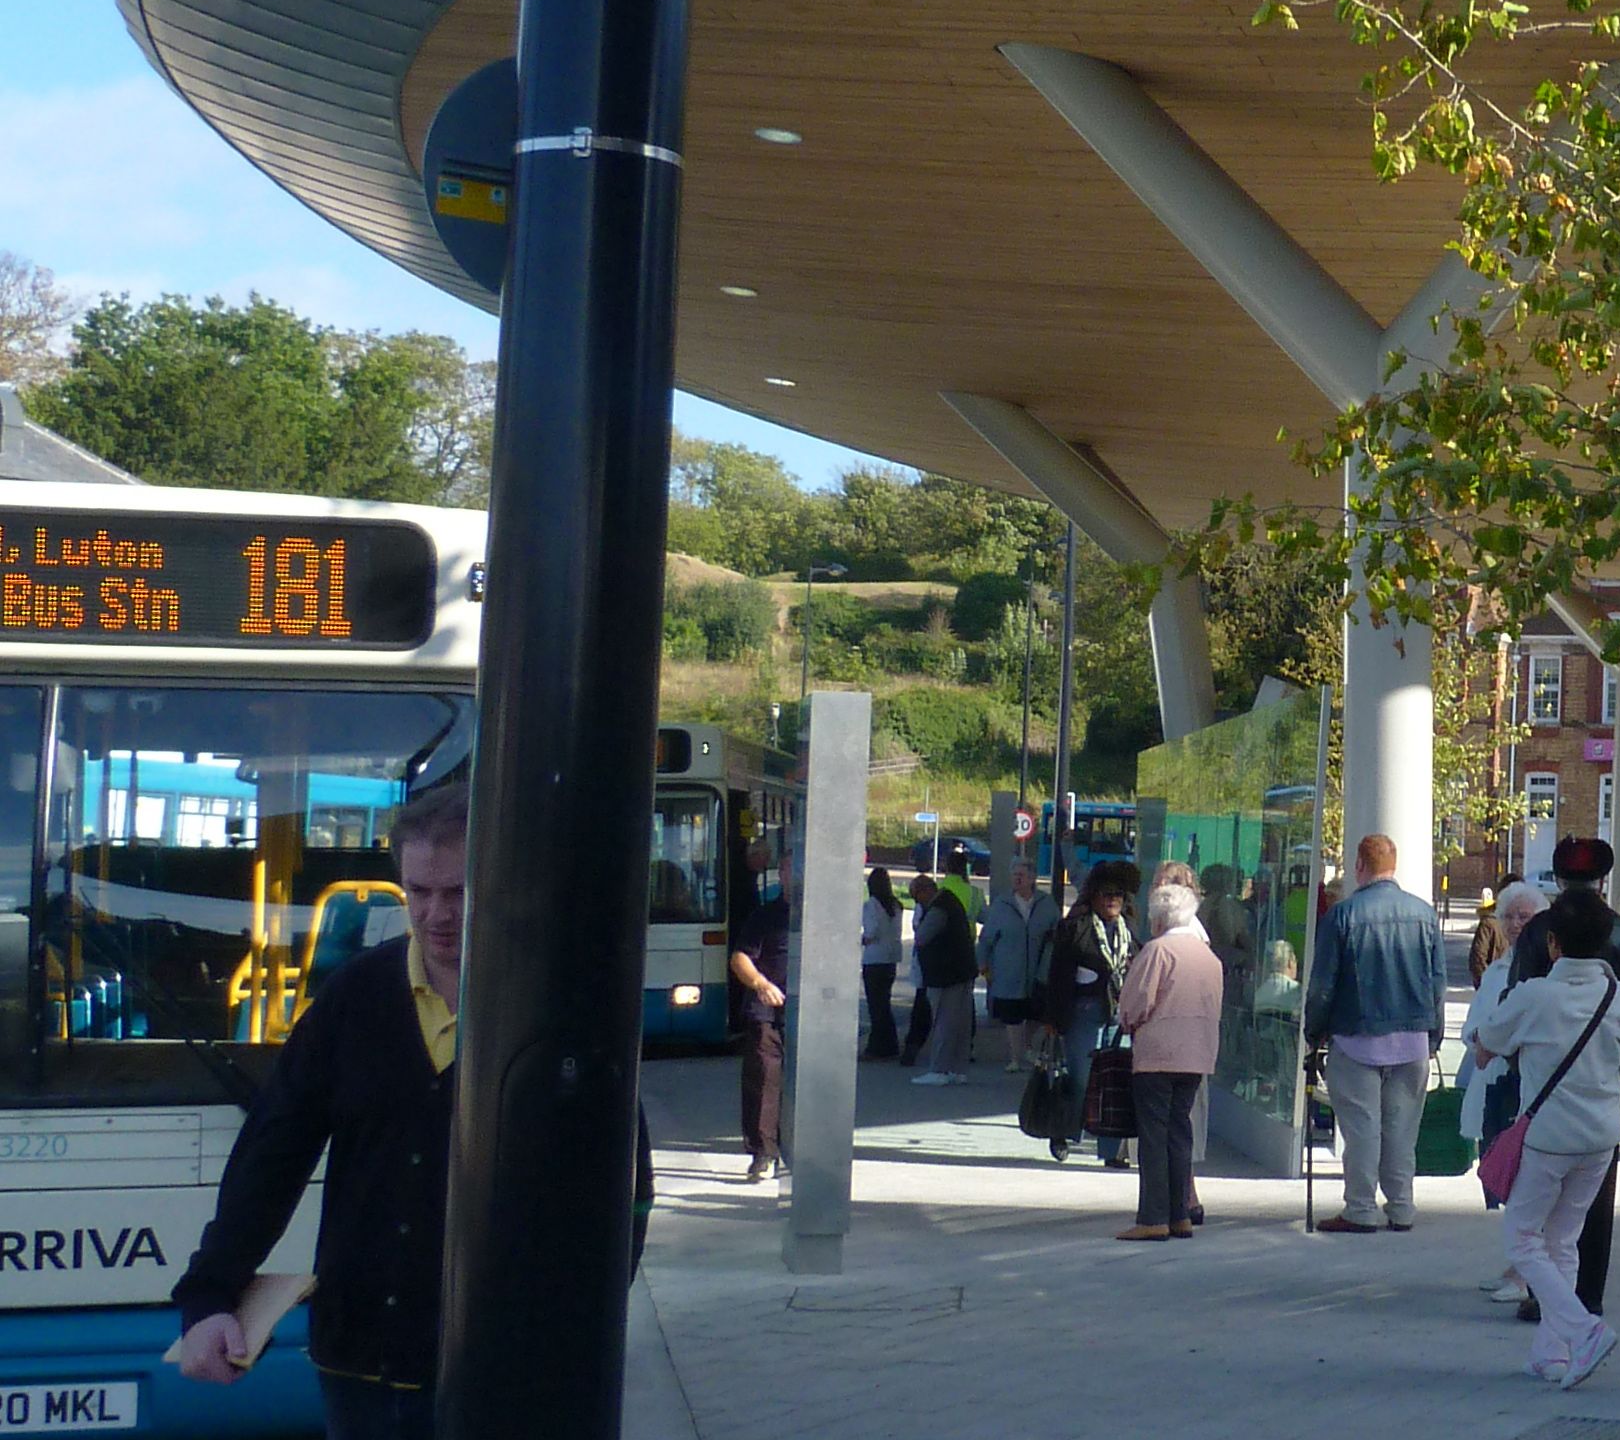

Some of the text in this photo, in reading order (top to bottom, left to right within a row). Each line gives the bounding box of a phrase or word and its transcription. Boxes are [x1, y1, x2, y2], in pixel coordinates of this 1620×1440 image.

[36, 526, 164, 569] Luton
[3, 573, 180, 632] Bus Stn
[240, 535, 352, 636] 181
[0, 1389, 120, 1426] 0 MKL
